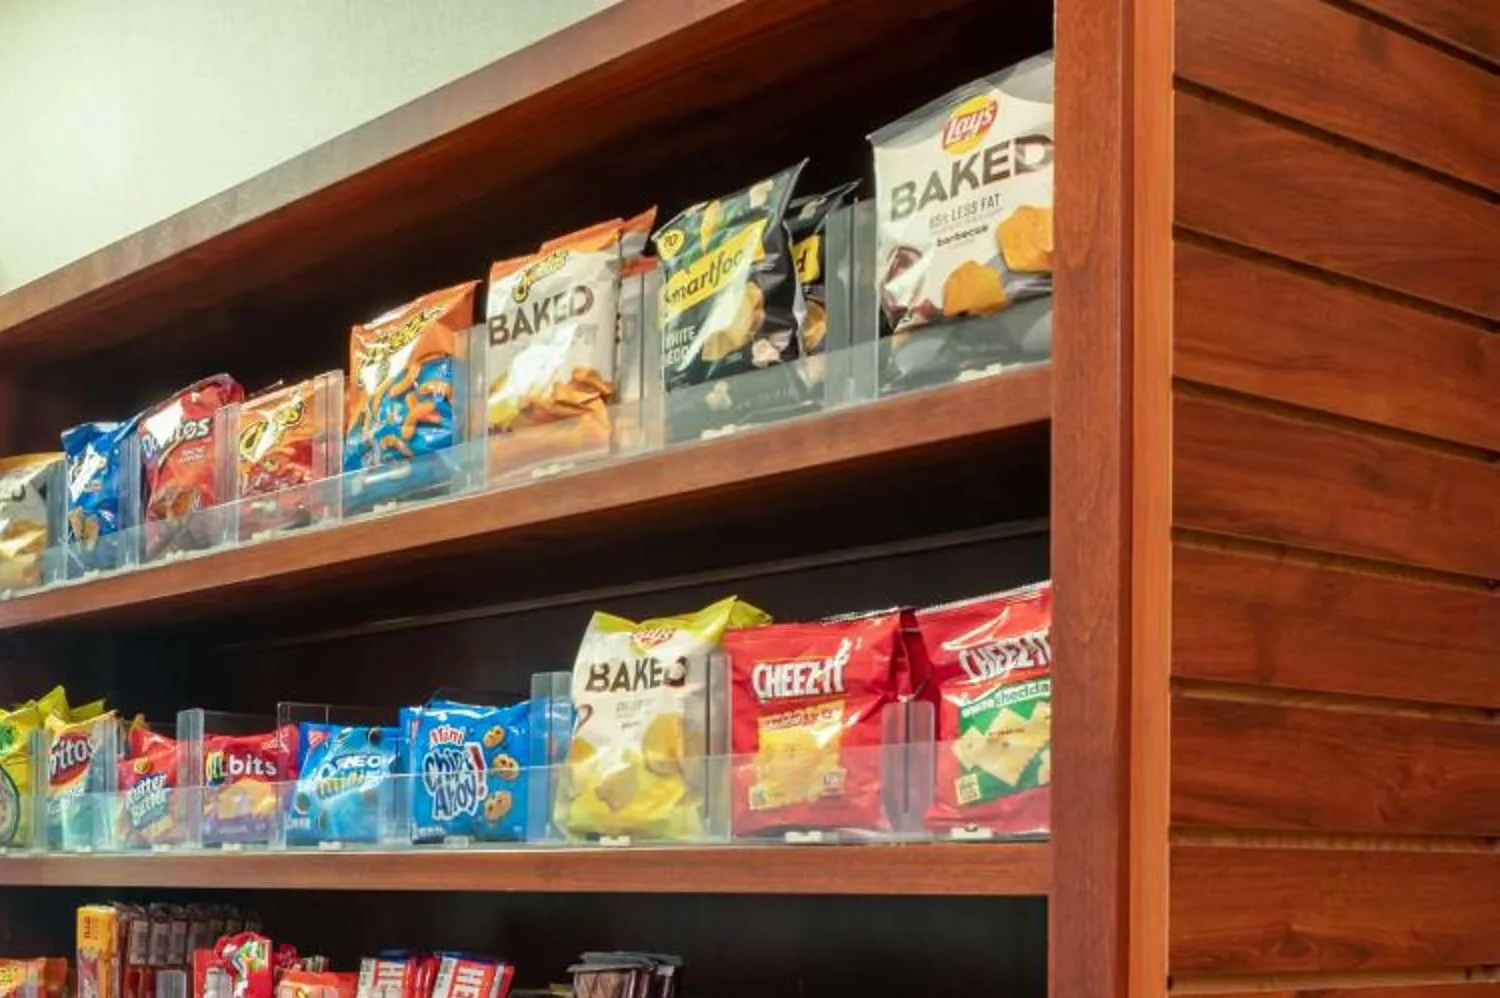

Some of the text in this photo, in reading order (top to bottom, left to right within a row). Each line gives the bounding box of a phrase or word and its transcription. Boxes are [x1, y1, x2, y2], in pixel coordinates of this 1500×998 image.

[945, 108, 993, 144] Lay's
[890, 133, 1054, 222] BAKED
[950, 201, 978, 222] LESS
[981, 193, 1001, 211] FAT
[488, 284, 594, 347] BAKED
[584, 655, 689, 693] BAKED
[229, 753, 278, 777] bits
